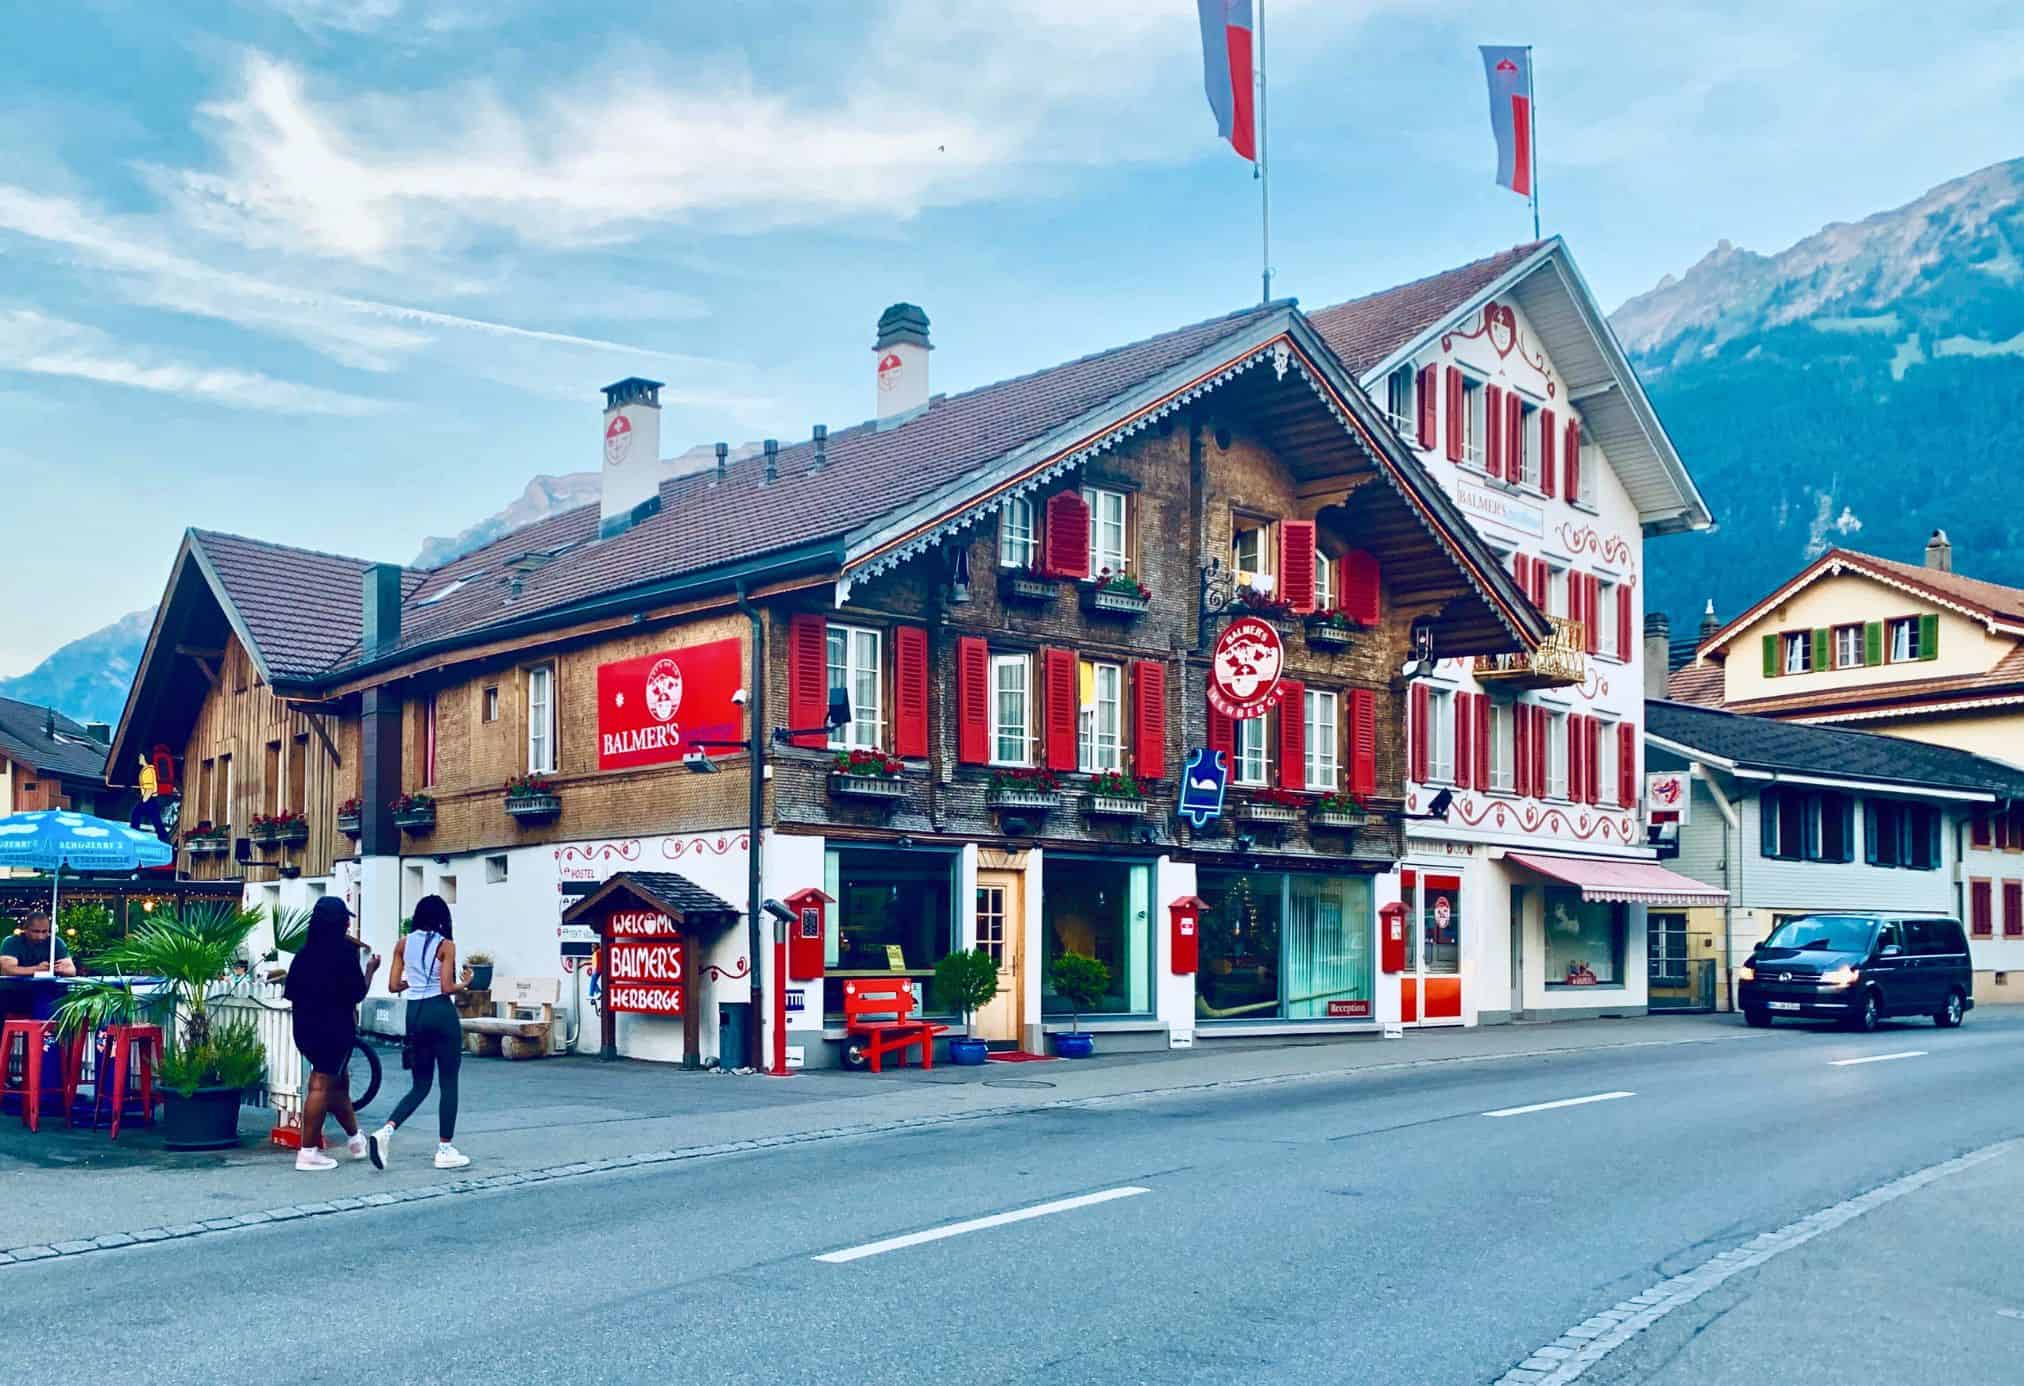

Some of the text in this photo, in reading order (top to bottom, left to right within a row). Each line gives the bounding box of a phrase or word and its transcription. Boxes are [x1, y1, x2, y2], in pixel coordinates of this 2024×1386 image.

[1207, 685, 1285, 718] HERBERGE
[603, 722, 680, 756] BALMER'S
[572, 868, 594, 879] HOSTEL
[610, 947, 681, 979] BALMER'S
[610, 988, 680, 1010] HERBERGE
[1330, 1003, 1366, 1014] Reception
